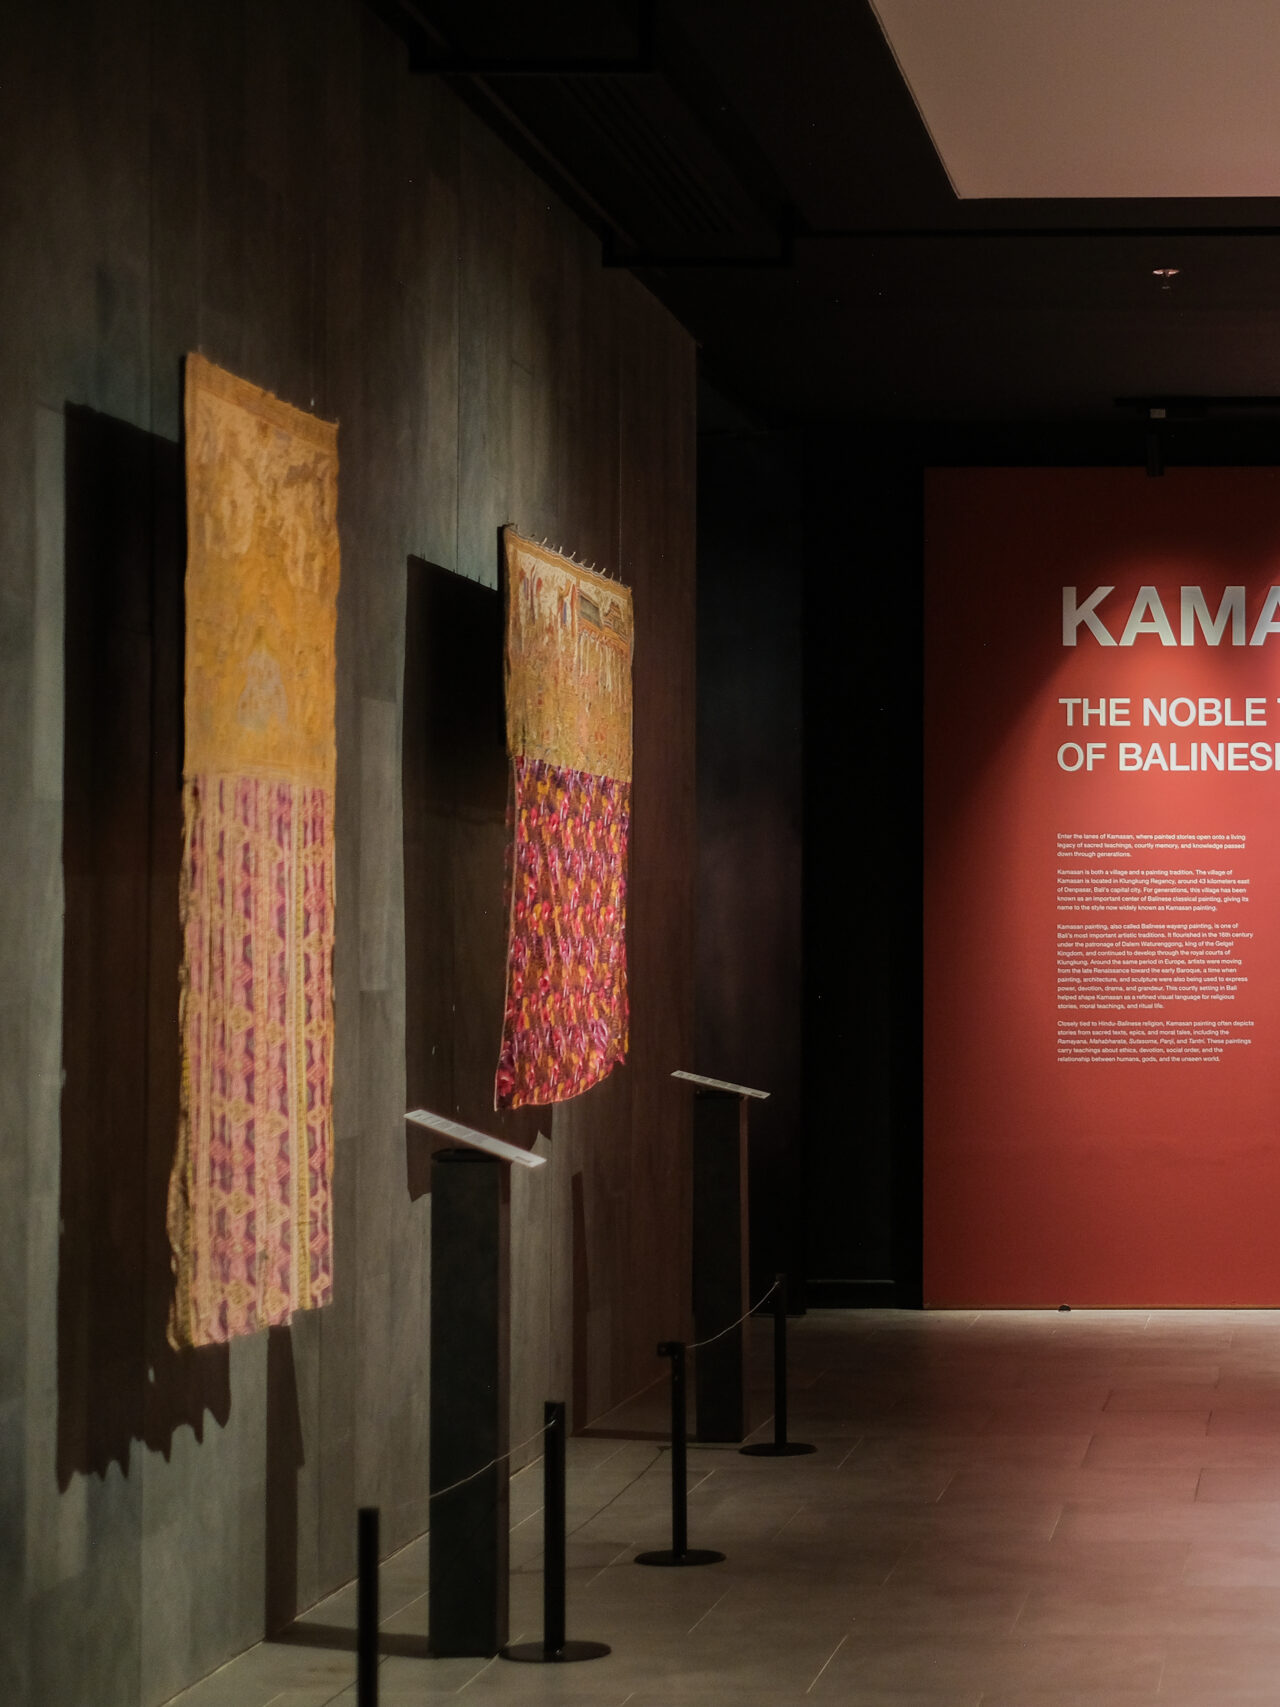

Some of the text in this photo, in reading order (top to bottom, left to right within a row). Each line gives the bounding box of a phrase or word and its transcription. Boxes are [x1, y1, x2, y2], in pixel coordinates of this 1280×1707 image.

[1058, 697, 1130, 727] THE
[1143, 697, 1267, 727] NOBLE
[1057, 742, 1106, 771] OF
[1154, 833, 1176, 841] painted
[1230, 833, 1246, 841] living
[1134, 842, 1154, 850] courtly
[1224, 842, 1246, 850] passed
[1074, 850, 1096, 858] through
[1110, 868, 1128, 876] village
[1145, 869, 1169, 877] painting
[1207, 869, 1226, 877] village
[1110, 886, 1130, 894] capital
[1202, 886, 1220, 894] village
[1091, 904, 1105, 912] style
[1119, 904, 1137, 912] widely
[1232, 931, 1254, 939] century
[1133, 949, 1156, 957] develop
[1157, 949, 1179, 957] through
[1190, 949, 1204, 957] royal
